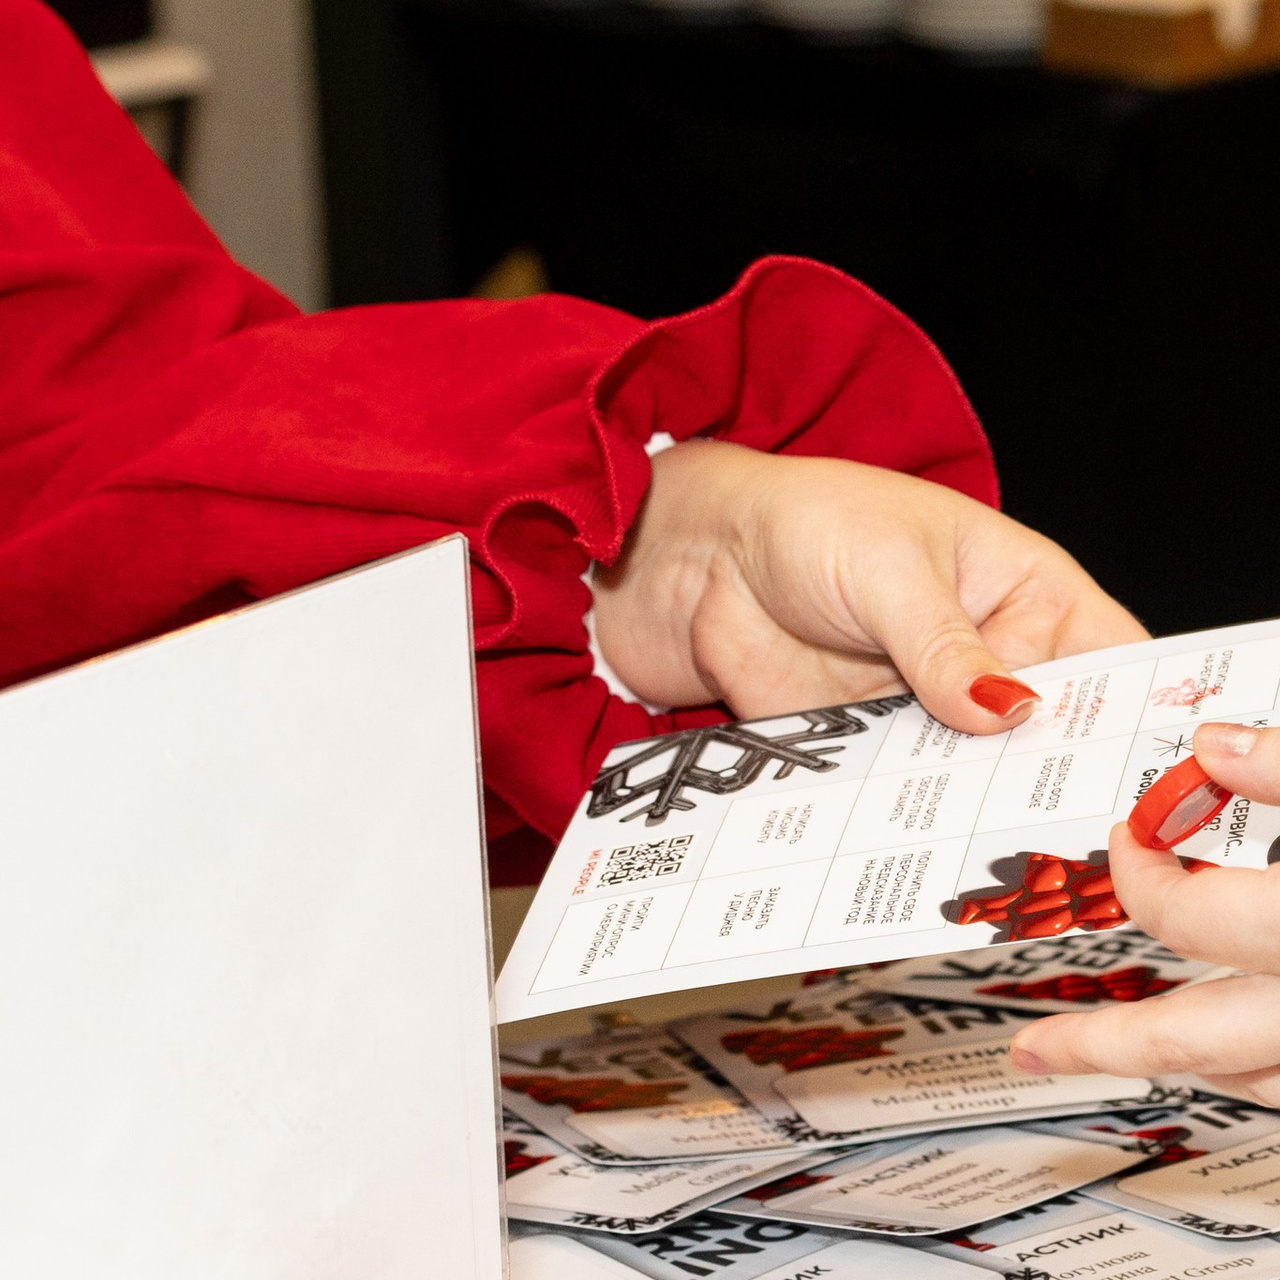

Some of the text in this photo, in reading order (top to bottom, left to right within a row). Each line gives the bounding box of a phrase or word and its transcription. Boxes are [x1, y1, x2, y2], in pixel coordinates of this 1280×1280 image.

[572, 849, 604, 896] MI PEOPLE
[843, 859, 877, 926] НА НОВЫЙ ГОД
[863, 856, 895, 925] ПРЕДСКАЗАНИЕ
[880, 853, 914, 925] ПЕРСОНАЛЬНОЕ
[906, 850, 932, 897] ПОЛУЧИТЬ
[629, 897, 654, 931] ПРОЙТИ
[718, 900, 742, 937] ДИДЖЕЯ
[741, 890, 763, 921] ПЕСНЮ
[754, 886, 781, 930] ЗАКАЗАТЬ
[578, 914, 612, 976] МЕРОПРИЯТИИ
[601, 900, 636, 959] МИНИ-ОПРОС
[1015, 1222, 1138, 1263] АСТНИК
[1182, 1255, 1257, 1280] Group
